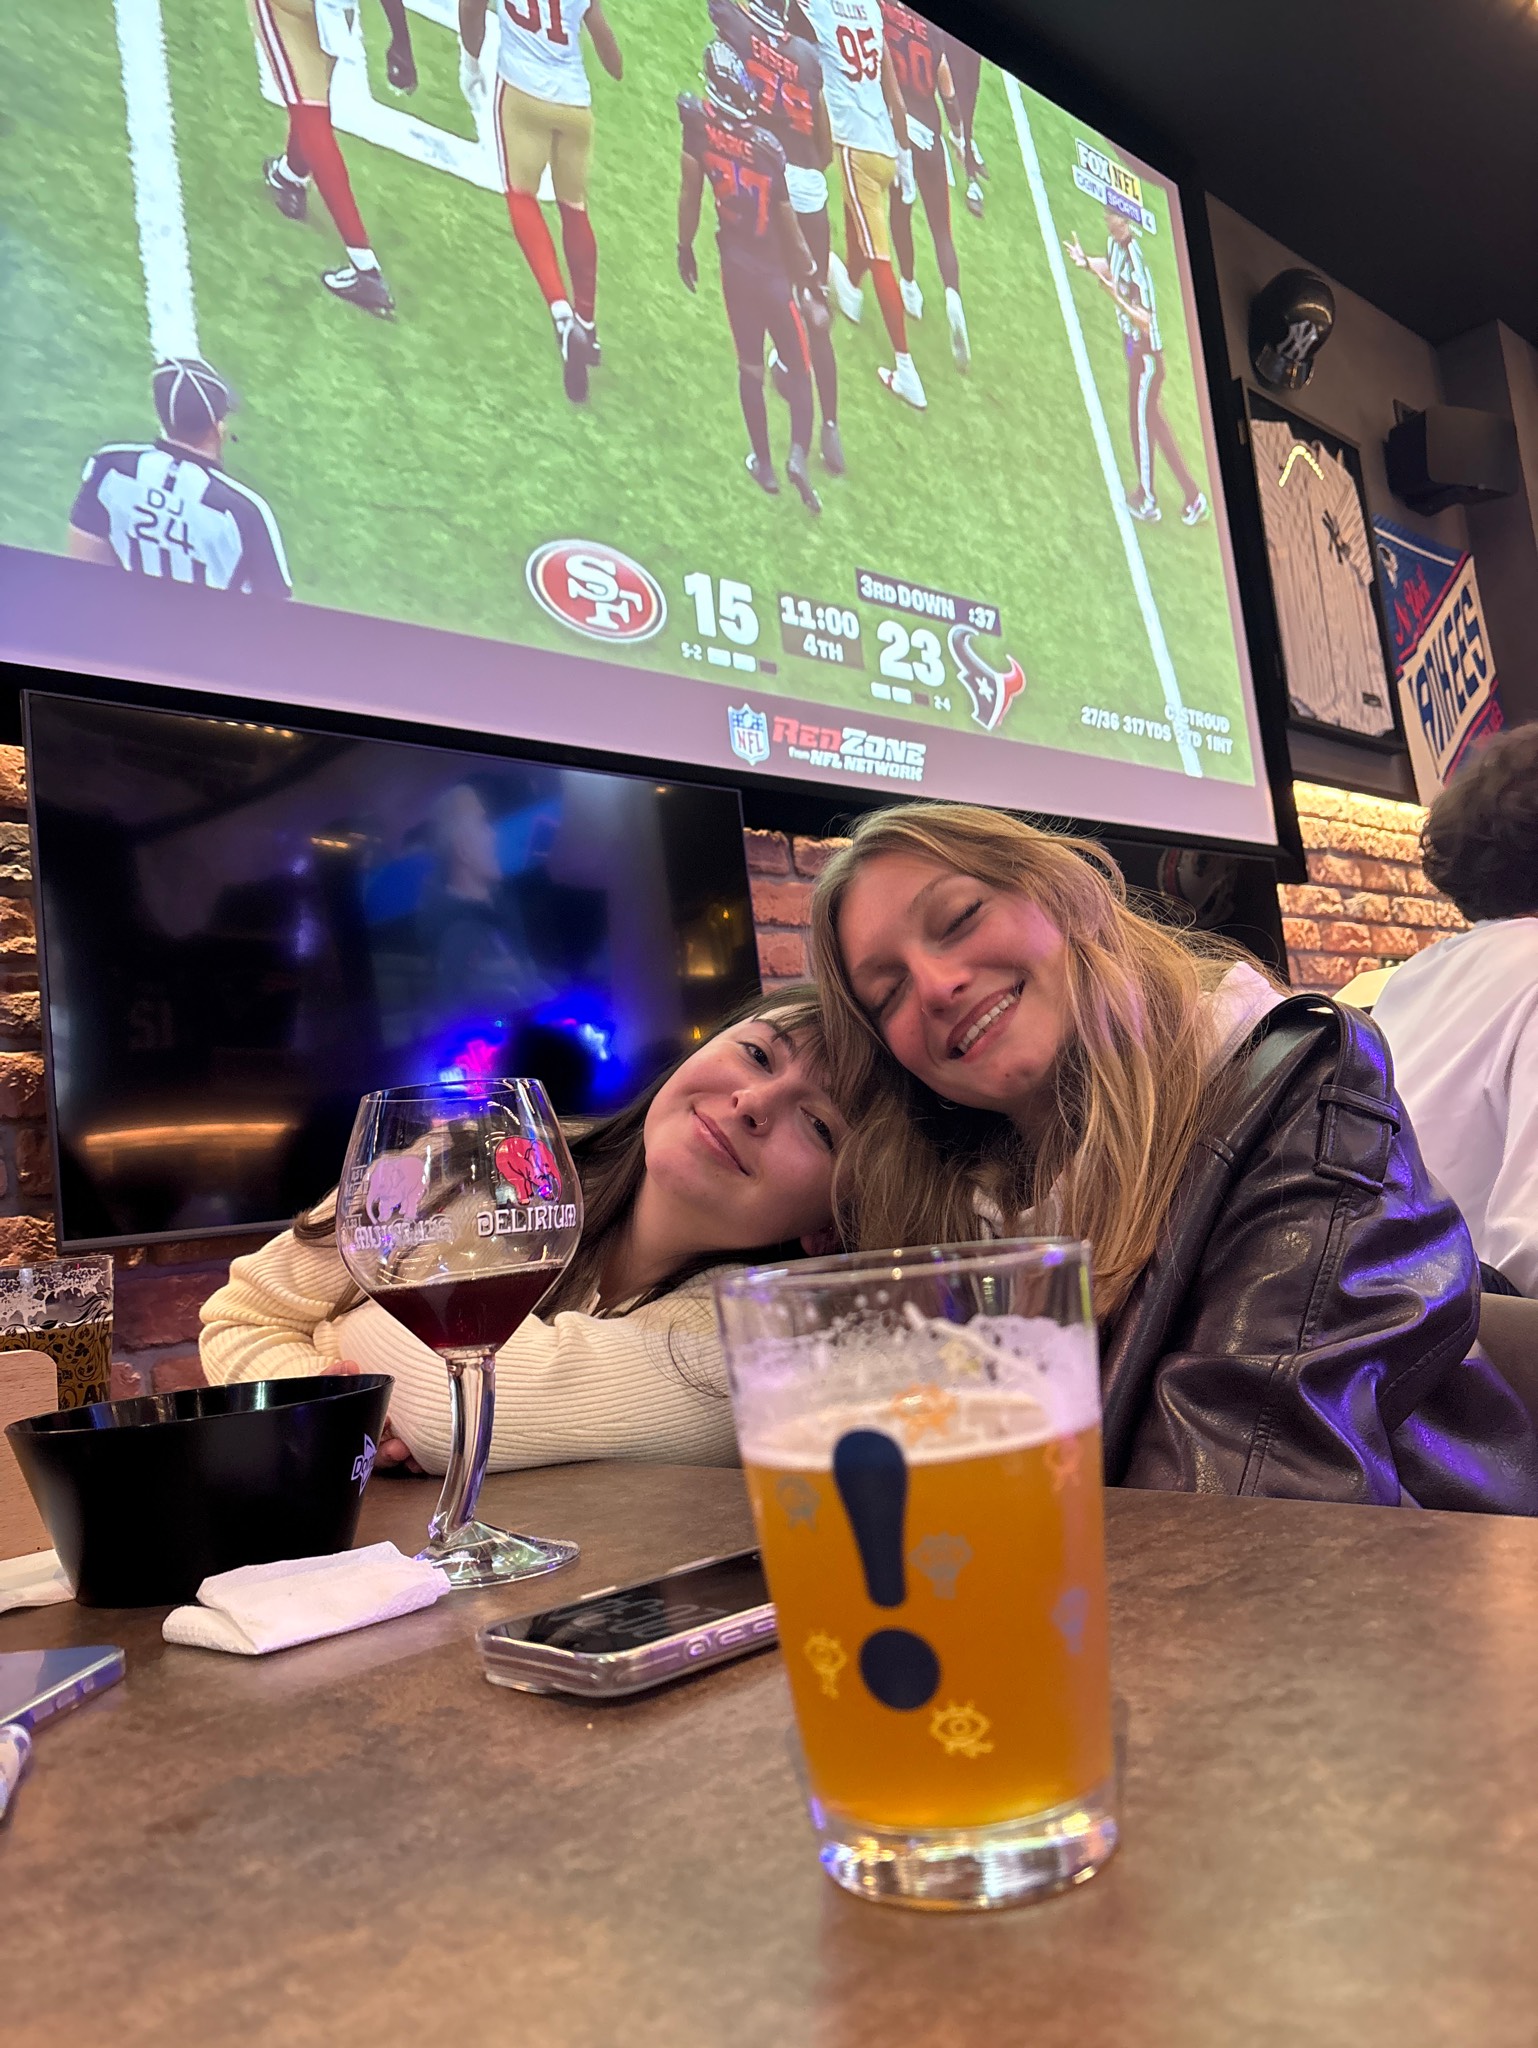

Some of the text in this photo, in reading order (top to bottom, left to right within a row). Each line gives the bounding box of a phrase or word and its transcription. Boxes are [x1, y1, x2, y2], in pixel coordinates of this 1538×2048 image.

[836, 25, 879, 82] 95
[1076, 142, 1140, 201] FOX NFL
[1106, 190, 1141, 223] SPORTS
[133, 505, 195, 555] 24
[564, 554, 643, 630] SF
[684, 572, 760, 646] 15
[860, 574, 897, 604] 3RD
[897, 584, 956, 620] DOWN
[780, 596, 860, 640] 11:00
[803, 633, 844, 662] 4TH
[876, 620, 946, 687] 23
[1407, 578, 1488, 775] YANKEES
[736, 729, 764, 757] NFL
[1081, 706, 1120, 731] 27/36
[1122, 715, 1145, 737] 317
[1145, 720, 1172, 742] YDS
[1213, 735, 1233, 756] INT
[810, 749, 843, 769] NFL
[843, 756, 925, 782] NETWORK
[477, 1203, 577, 1238] DELIRIUM
